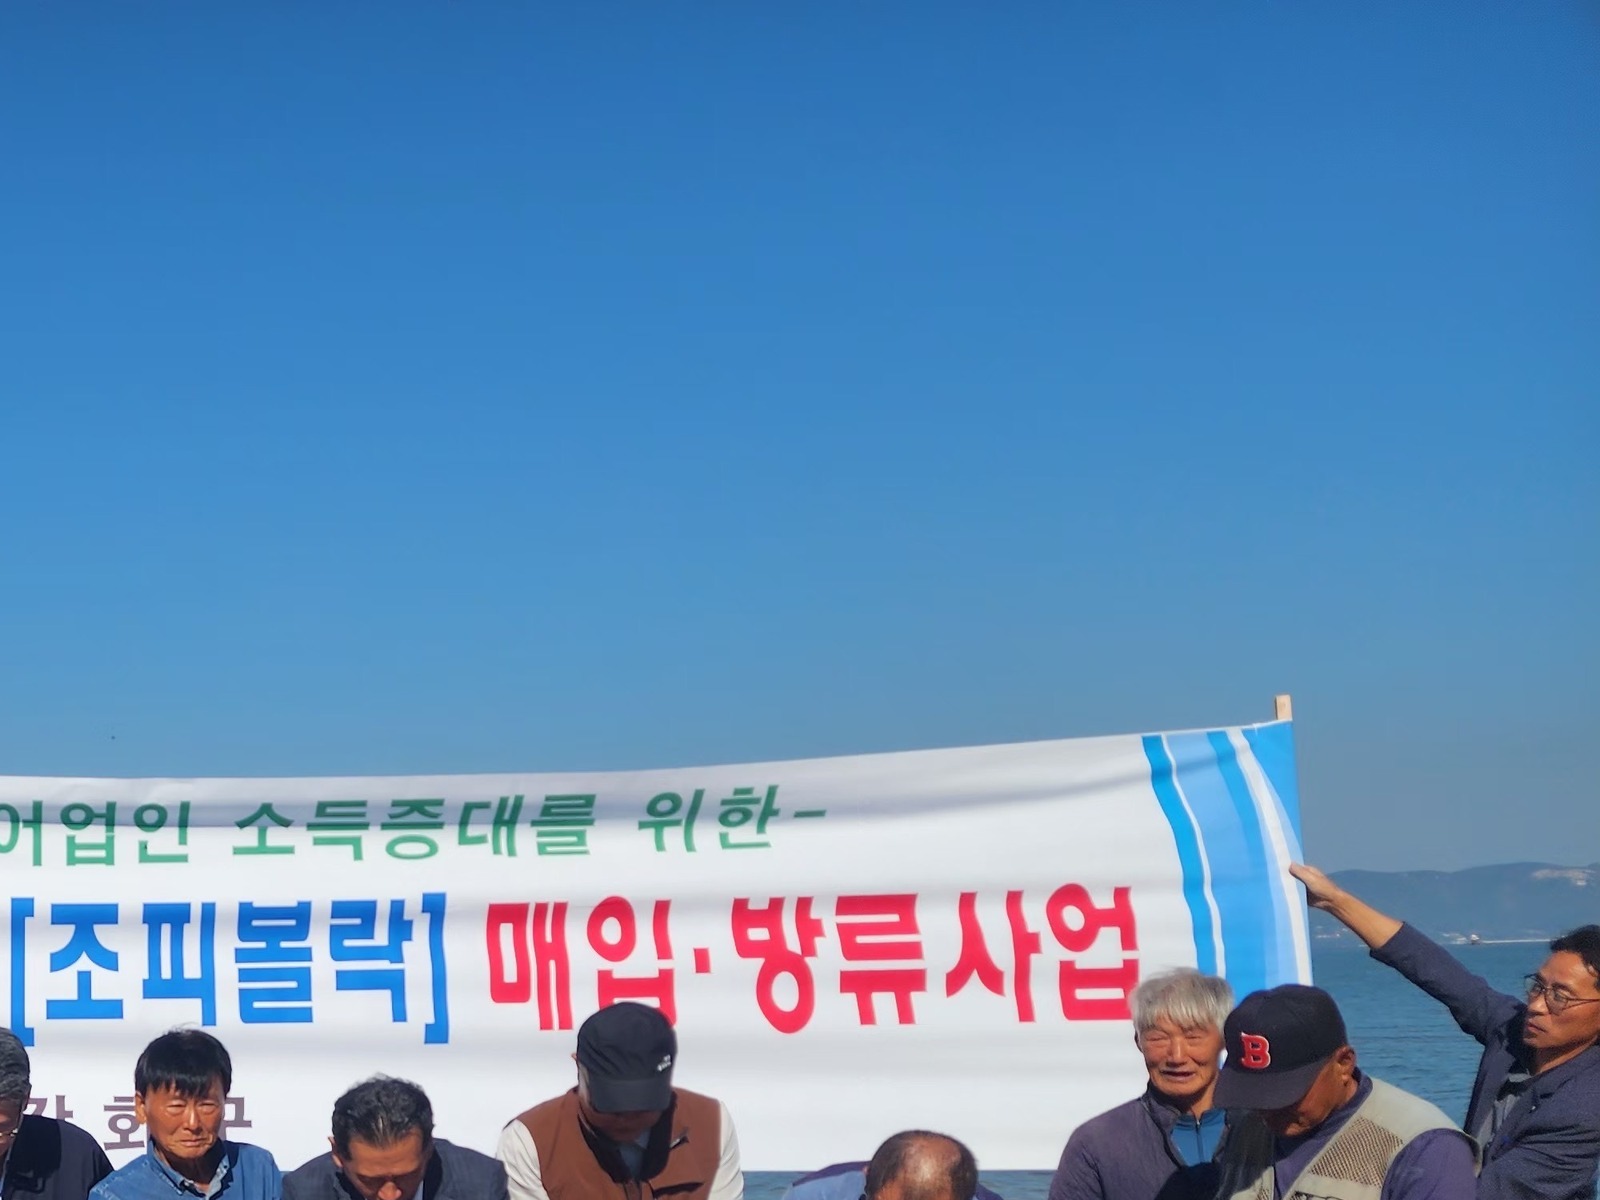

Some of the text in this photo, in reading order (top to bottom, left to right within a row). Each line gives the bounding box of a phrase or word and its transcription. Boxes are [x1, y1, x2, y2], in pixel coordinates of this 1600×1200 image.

[232, 794, 597, 862] 소득증대를
[10, 893, 449, 1047] [조피볼락]
[486, 883, 1138, 1034] 매입·방류사업
[1241, 1032, 1271, 1069] B
